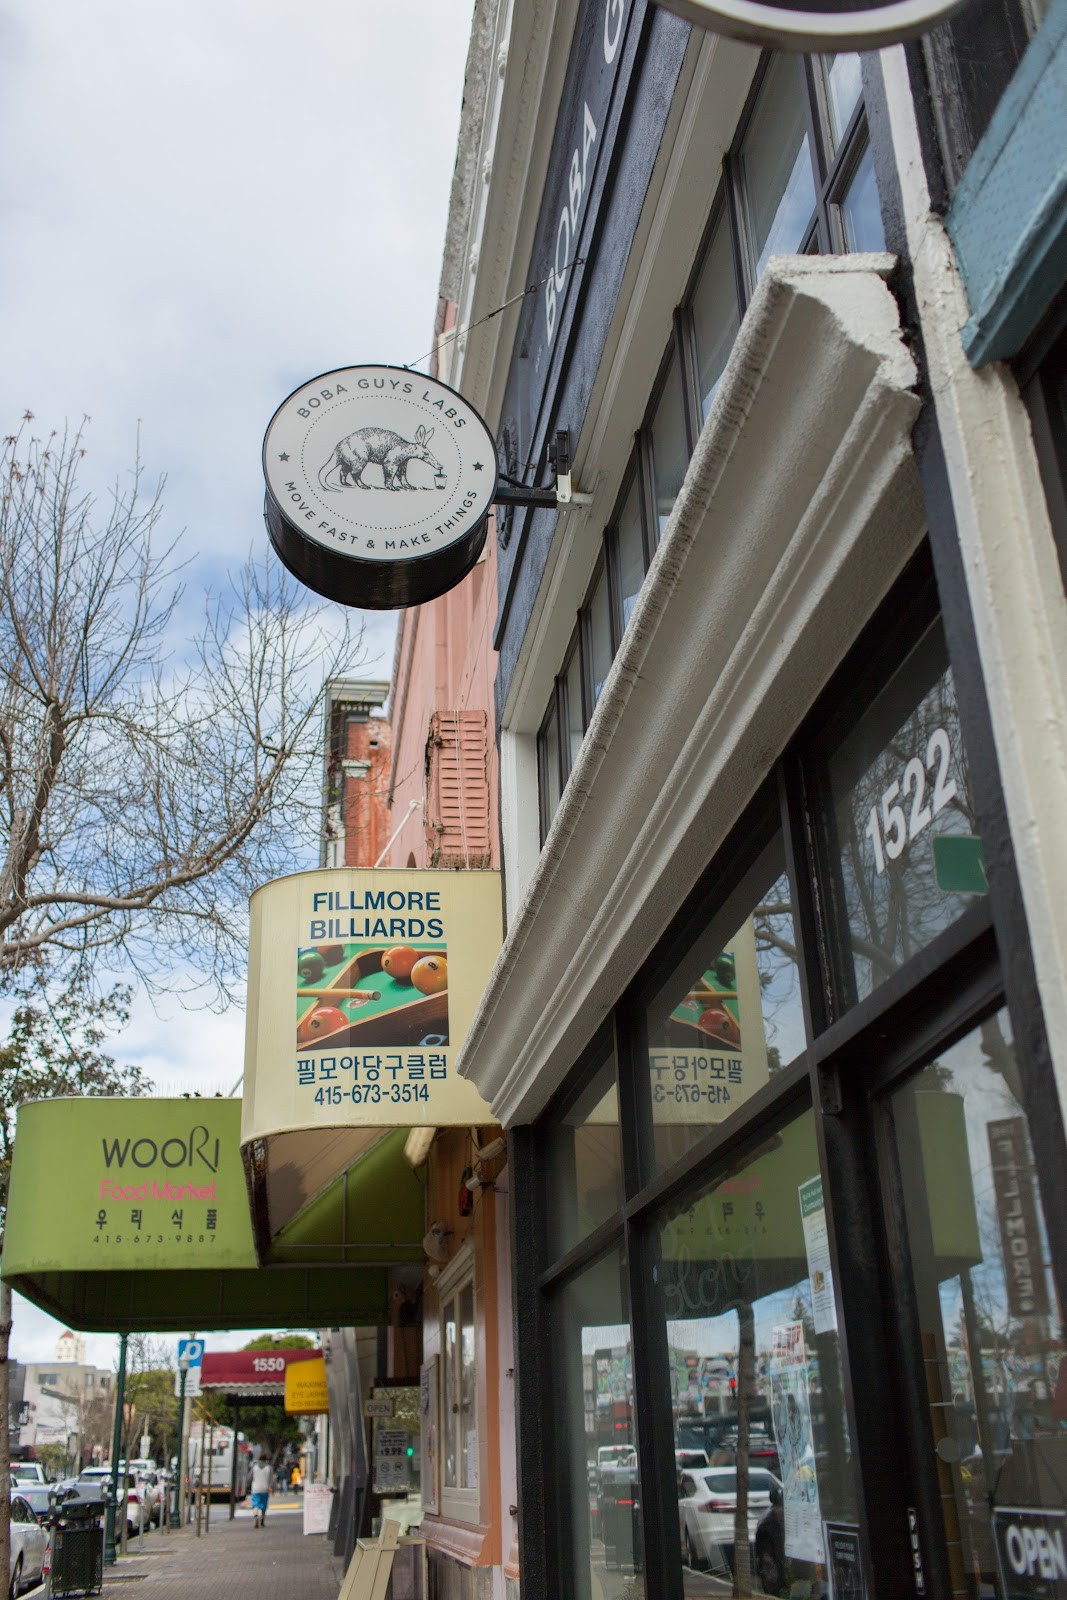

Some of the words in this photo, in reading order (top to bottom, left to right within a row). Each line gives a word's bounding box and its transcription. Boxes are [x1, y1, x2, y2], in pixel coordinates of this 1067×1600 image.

[546, 102, 597, 346] BOBA
[297, 384, 348, 419] BOBA
[358, 379, 413, 394] GUYS
[422, 391, 467, 429] LABS
[284, 481, 316, 520] MOVE
[318, 521, 358, 544] FAST
[366, 539, 376, 549] &
[385, 533, 431, 549] MAKE
[435, 490, 478, 535] THINGS
[866, 728, 957, 874] 1522
[313, 890, 441, 912] FILLMORE
[310, 917, 444, 940] BILLIARDS
[297, 1054, 447, 1085] 필모아당구클럽
[314, 1083, 430, 1105] 415-673-3514
[102, 1126, 220, 1173] WOORI
[100, 1180, 149, 1200] Food
[151, 1180, 217, 1200] Market
[253, 1357, 285, 1372] 1550
[1006, 1524, 1067, 1580] OPEN
